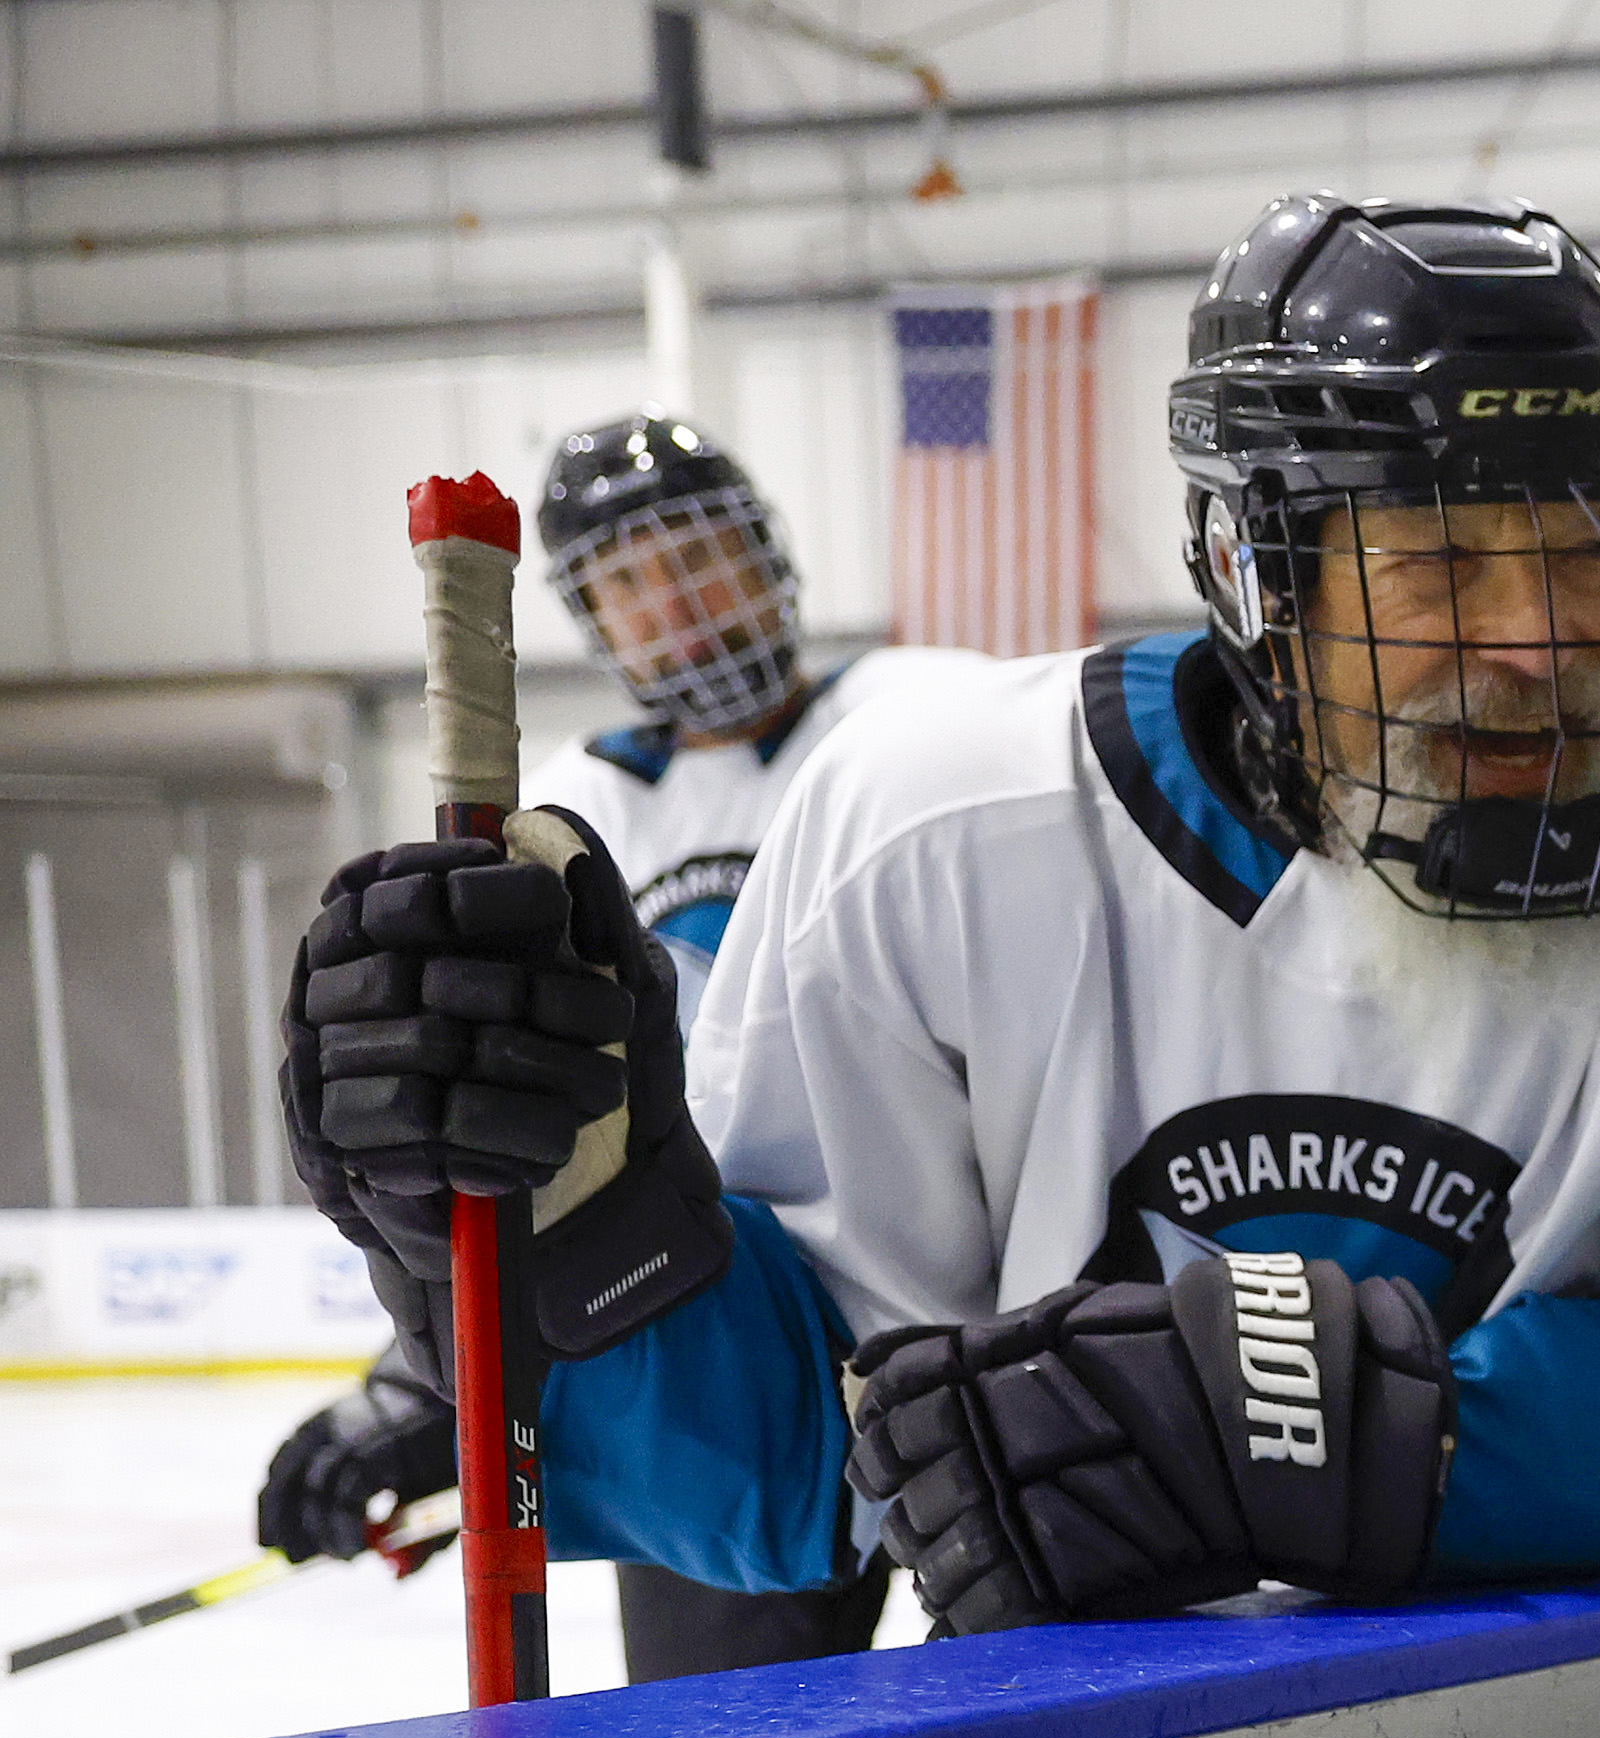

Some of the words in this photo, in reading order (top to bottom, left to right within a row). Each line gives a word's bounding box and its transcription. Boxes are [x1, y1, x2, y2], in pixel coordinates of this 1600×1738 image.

[1170, 410, 1217, 442] CCM
[1167, 1131, 1406, 1216] SHARKS
[1410, 1158, 1496, 1243] ICE
